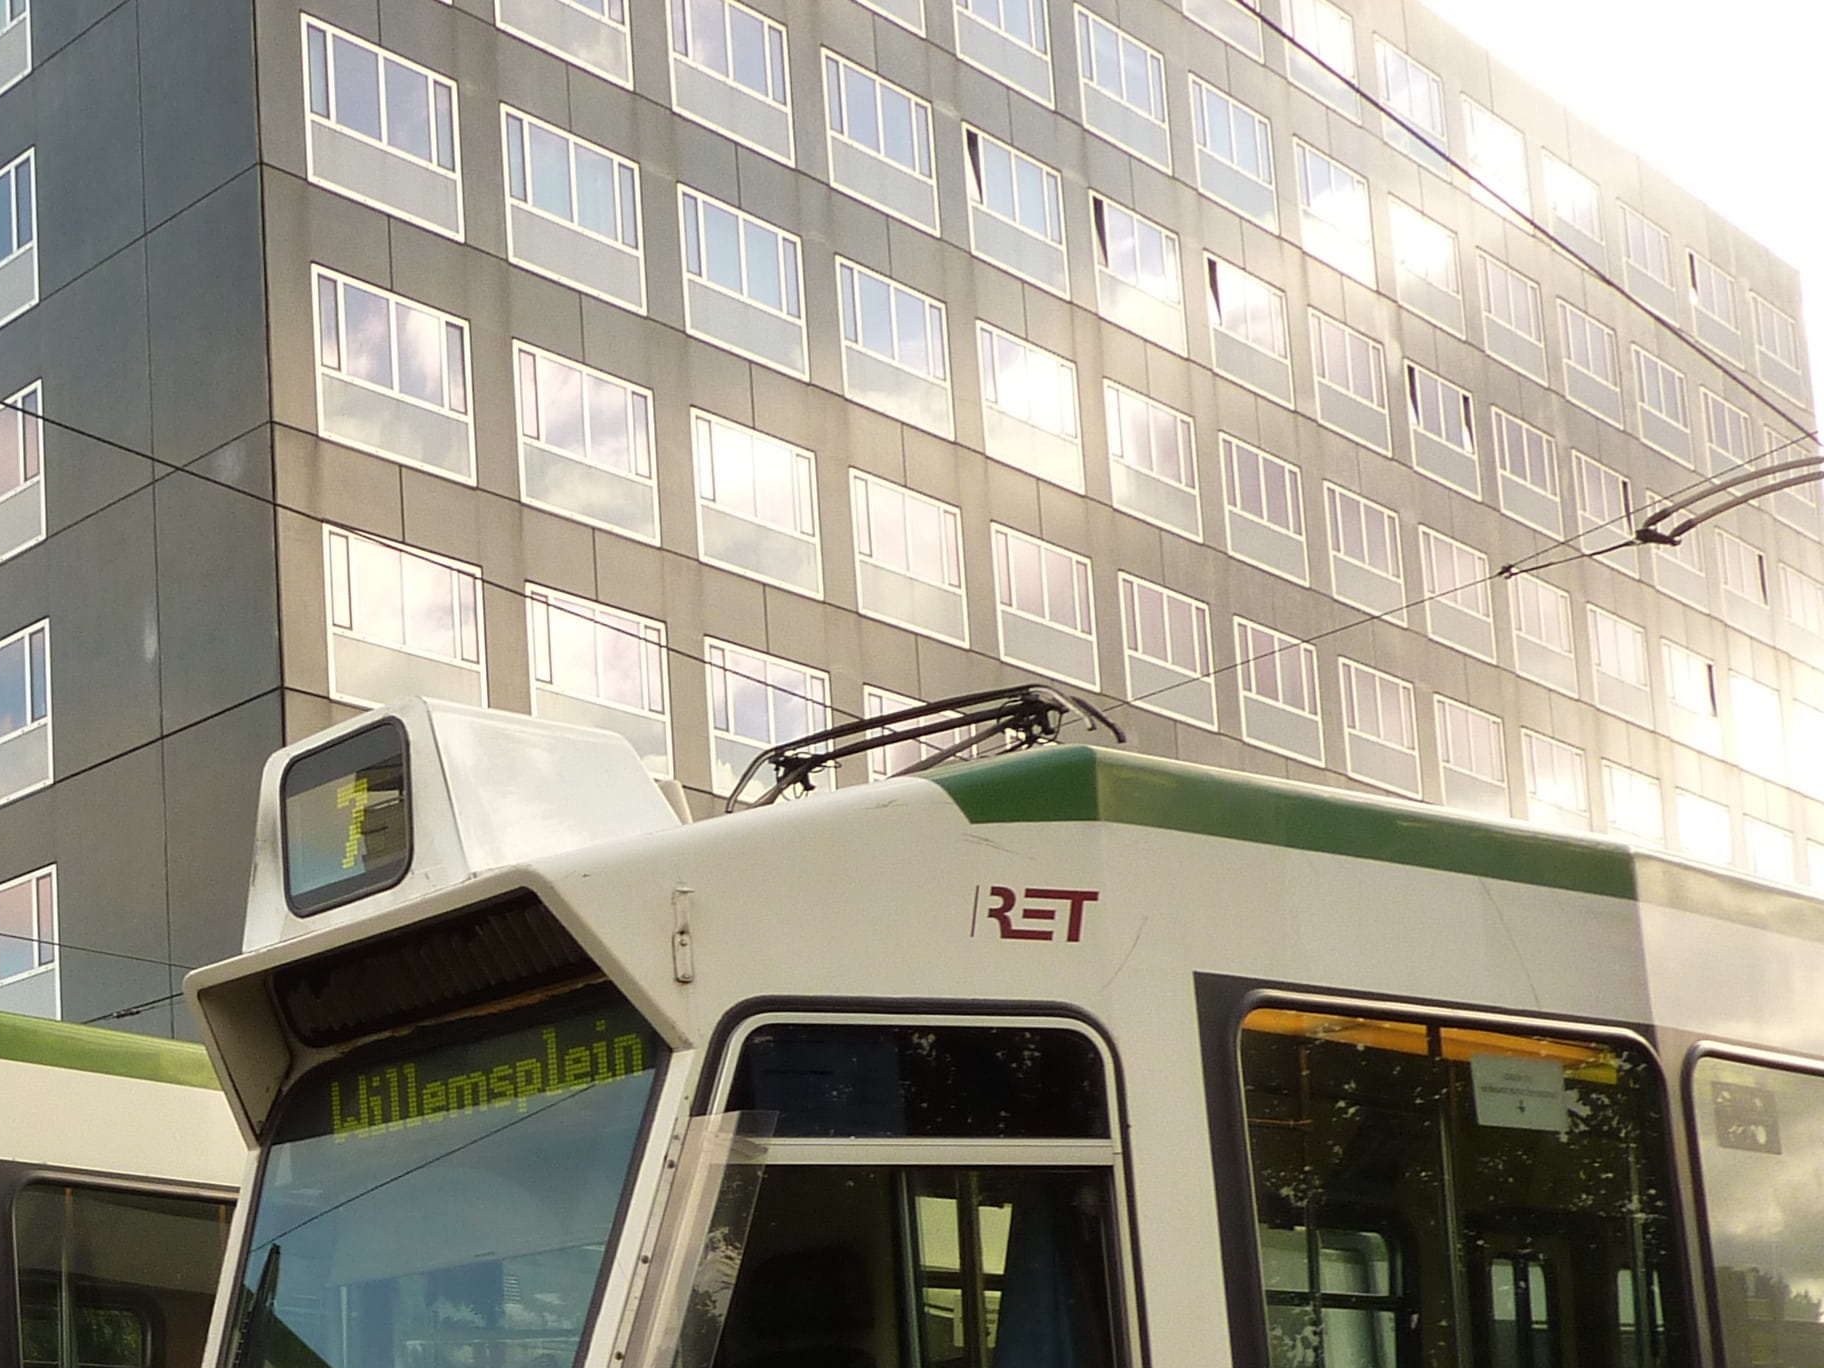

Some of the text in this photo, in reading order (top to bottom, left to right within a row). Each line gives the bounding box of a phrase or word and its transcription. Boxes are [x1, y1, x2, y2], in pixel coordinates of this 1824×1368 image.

[337, 778, 368, 869] 7
[987, 886, 1100, 942] RET
[330, 1019, 643, 1143] Willemsplein
